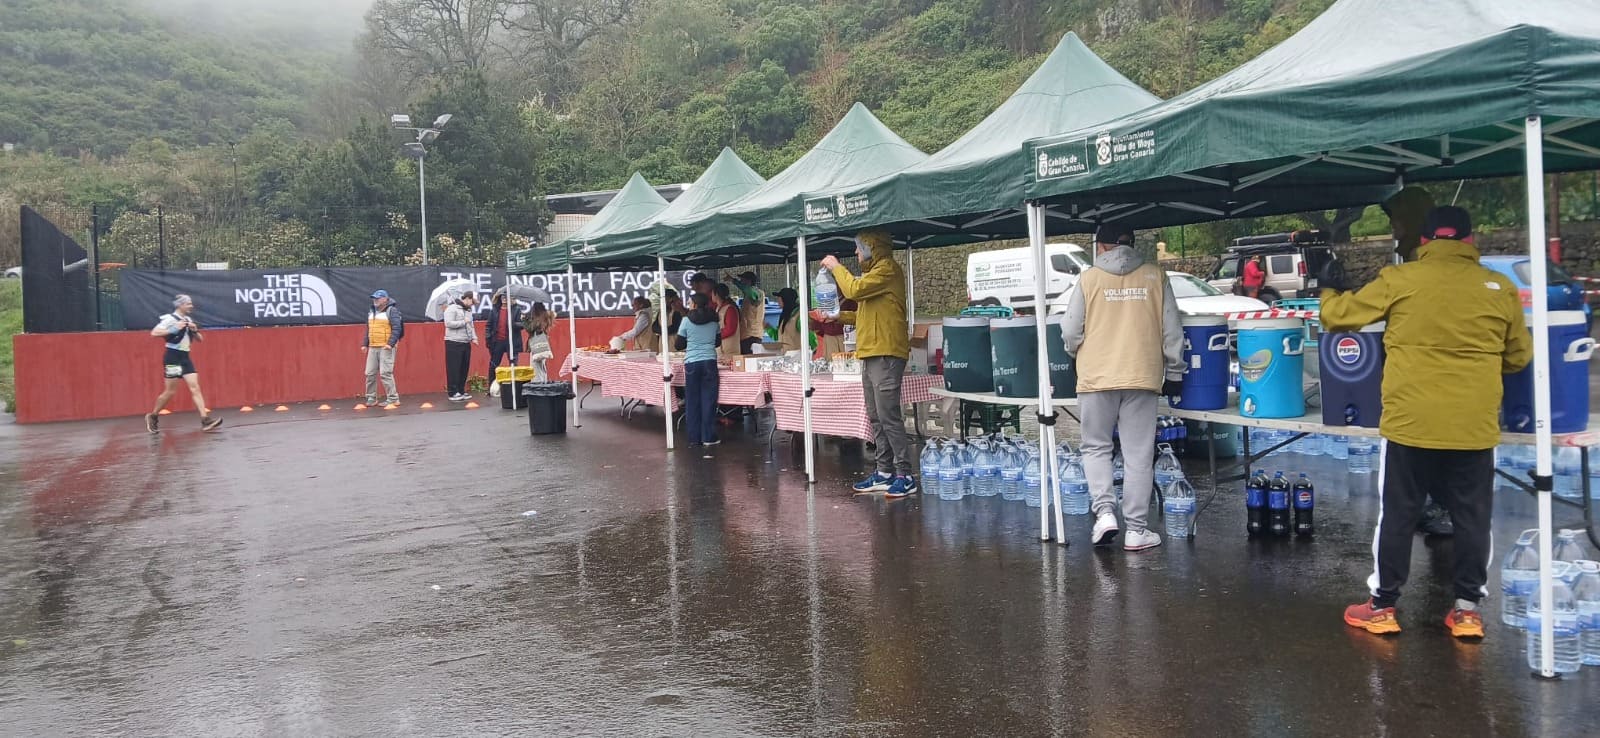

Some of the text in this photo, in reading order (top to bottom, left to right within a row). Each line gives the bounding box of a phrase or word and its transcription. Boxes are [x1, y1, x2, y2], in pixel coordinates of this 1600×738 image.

[1113, 138, 1155, 154] Villa de Moya
[1048, 155, 1078, 168] Cabildo de
[1114, 148, 1155, 162] Gran Canaria
[1048, 162, 1085, 176] Gran Canaria
[263, 274, 300, 288] THE
[235, 288, 301, 304] NORTH
[1104, 288, 1148, 296] VOLUNTEER
[254, 302, 302, 318] FACE
[951, 360, 968, 369] Teror
[1000, 367, 1018, 376] Teror
